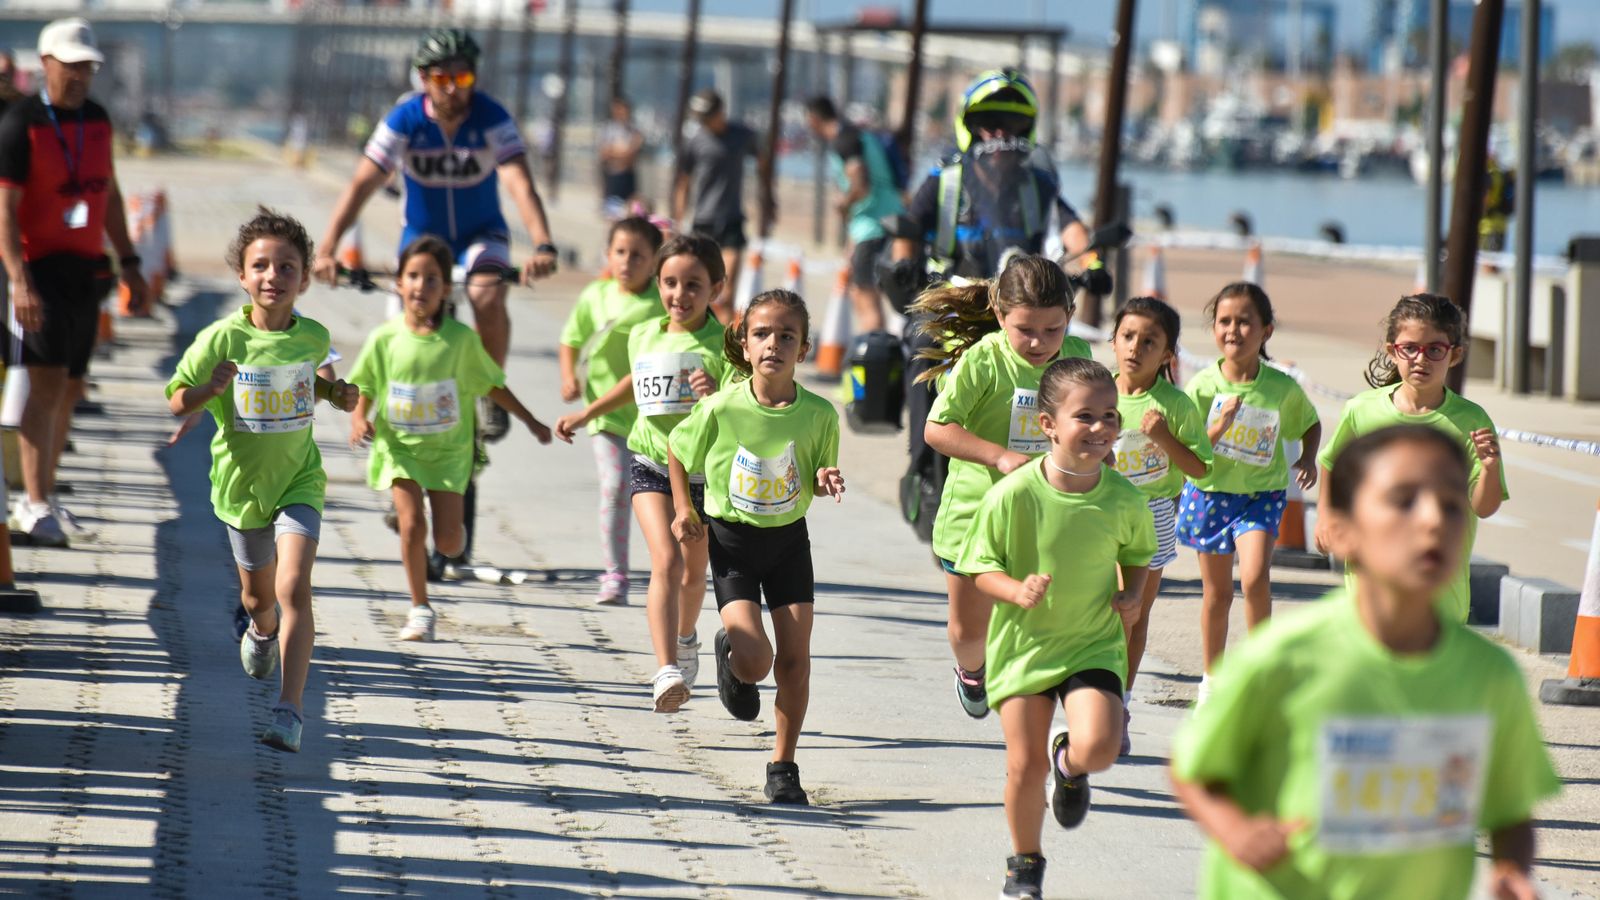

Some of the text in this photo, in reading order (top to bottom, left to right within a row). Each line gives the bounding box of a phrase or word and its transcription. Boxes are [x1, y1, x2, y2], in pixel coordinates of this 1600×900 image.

[412, 154, 481, 177] UCA
[238, 372, 253, 382] XXI
[637, 375, 674, 399] 1557
[240, 388, 294, 415] 1509
[1017, 395, 1034, 406] XXI
[736, 470, 786, 499] 1220
[1333, 768, 1438, 817] 1473
